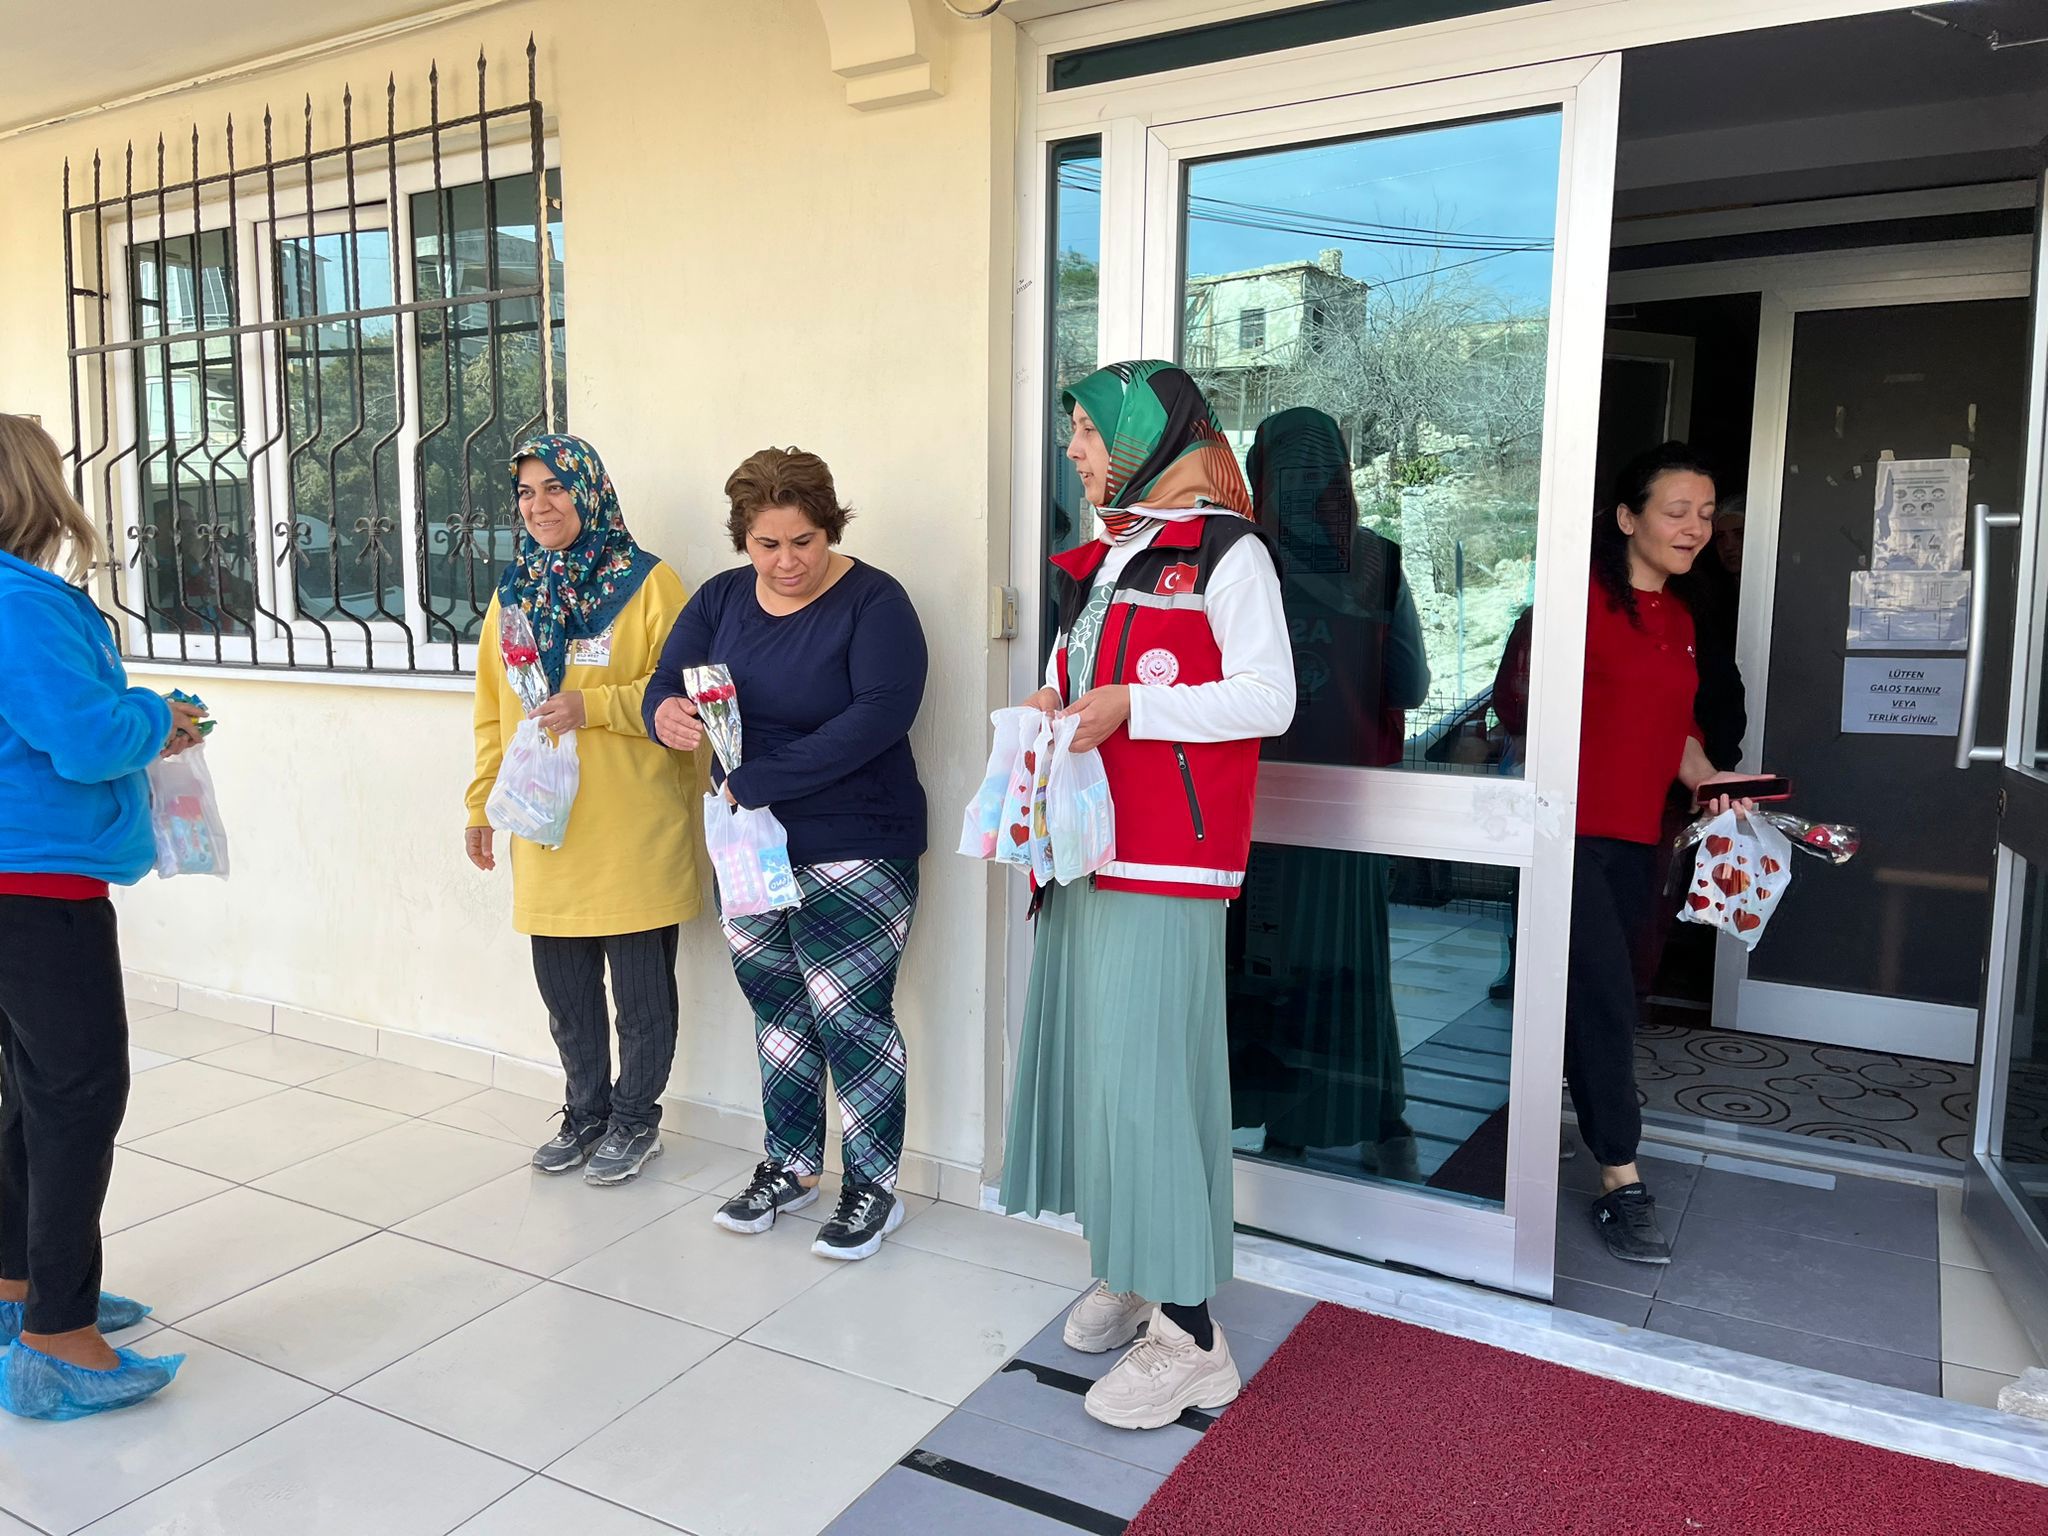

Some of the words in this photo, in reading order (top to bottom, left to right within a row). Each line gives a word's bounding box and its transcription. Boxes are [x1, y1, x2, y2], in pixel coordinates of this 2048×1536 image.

[1888, 669, 1925, 679] LÜTFEN
[1870, 684, 1901, 694] GALOŞ
[1904, 685, 1941, 695] TAKINIZ
[1892, 700, 1916, 708] VEYA
[1868, 713, 1899, 723] TERLİK
